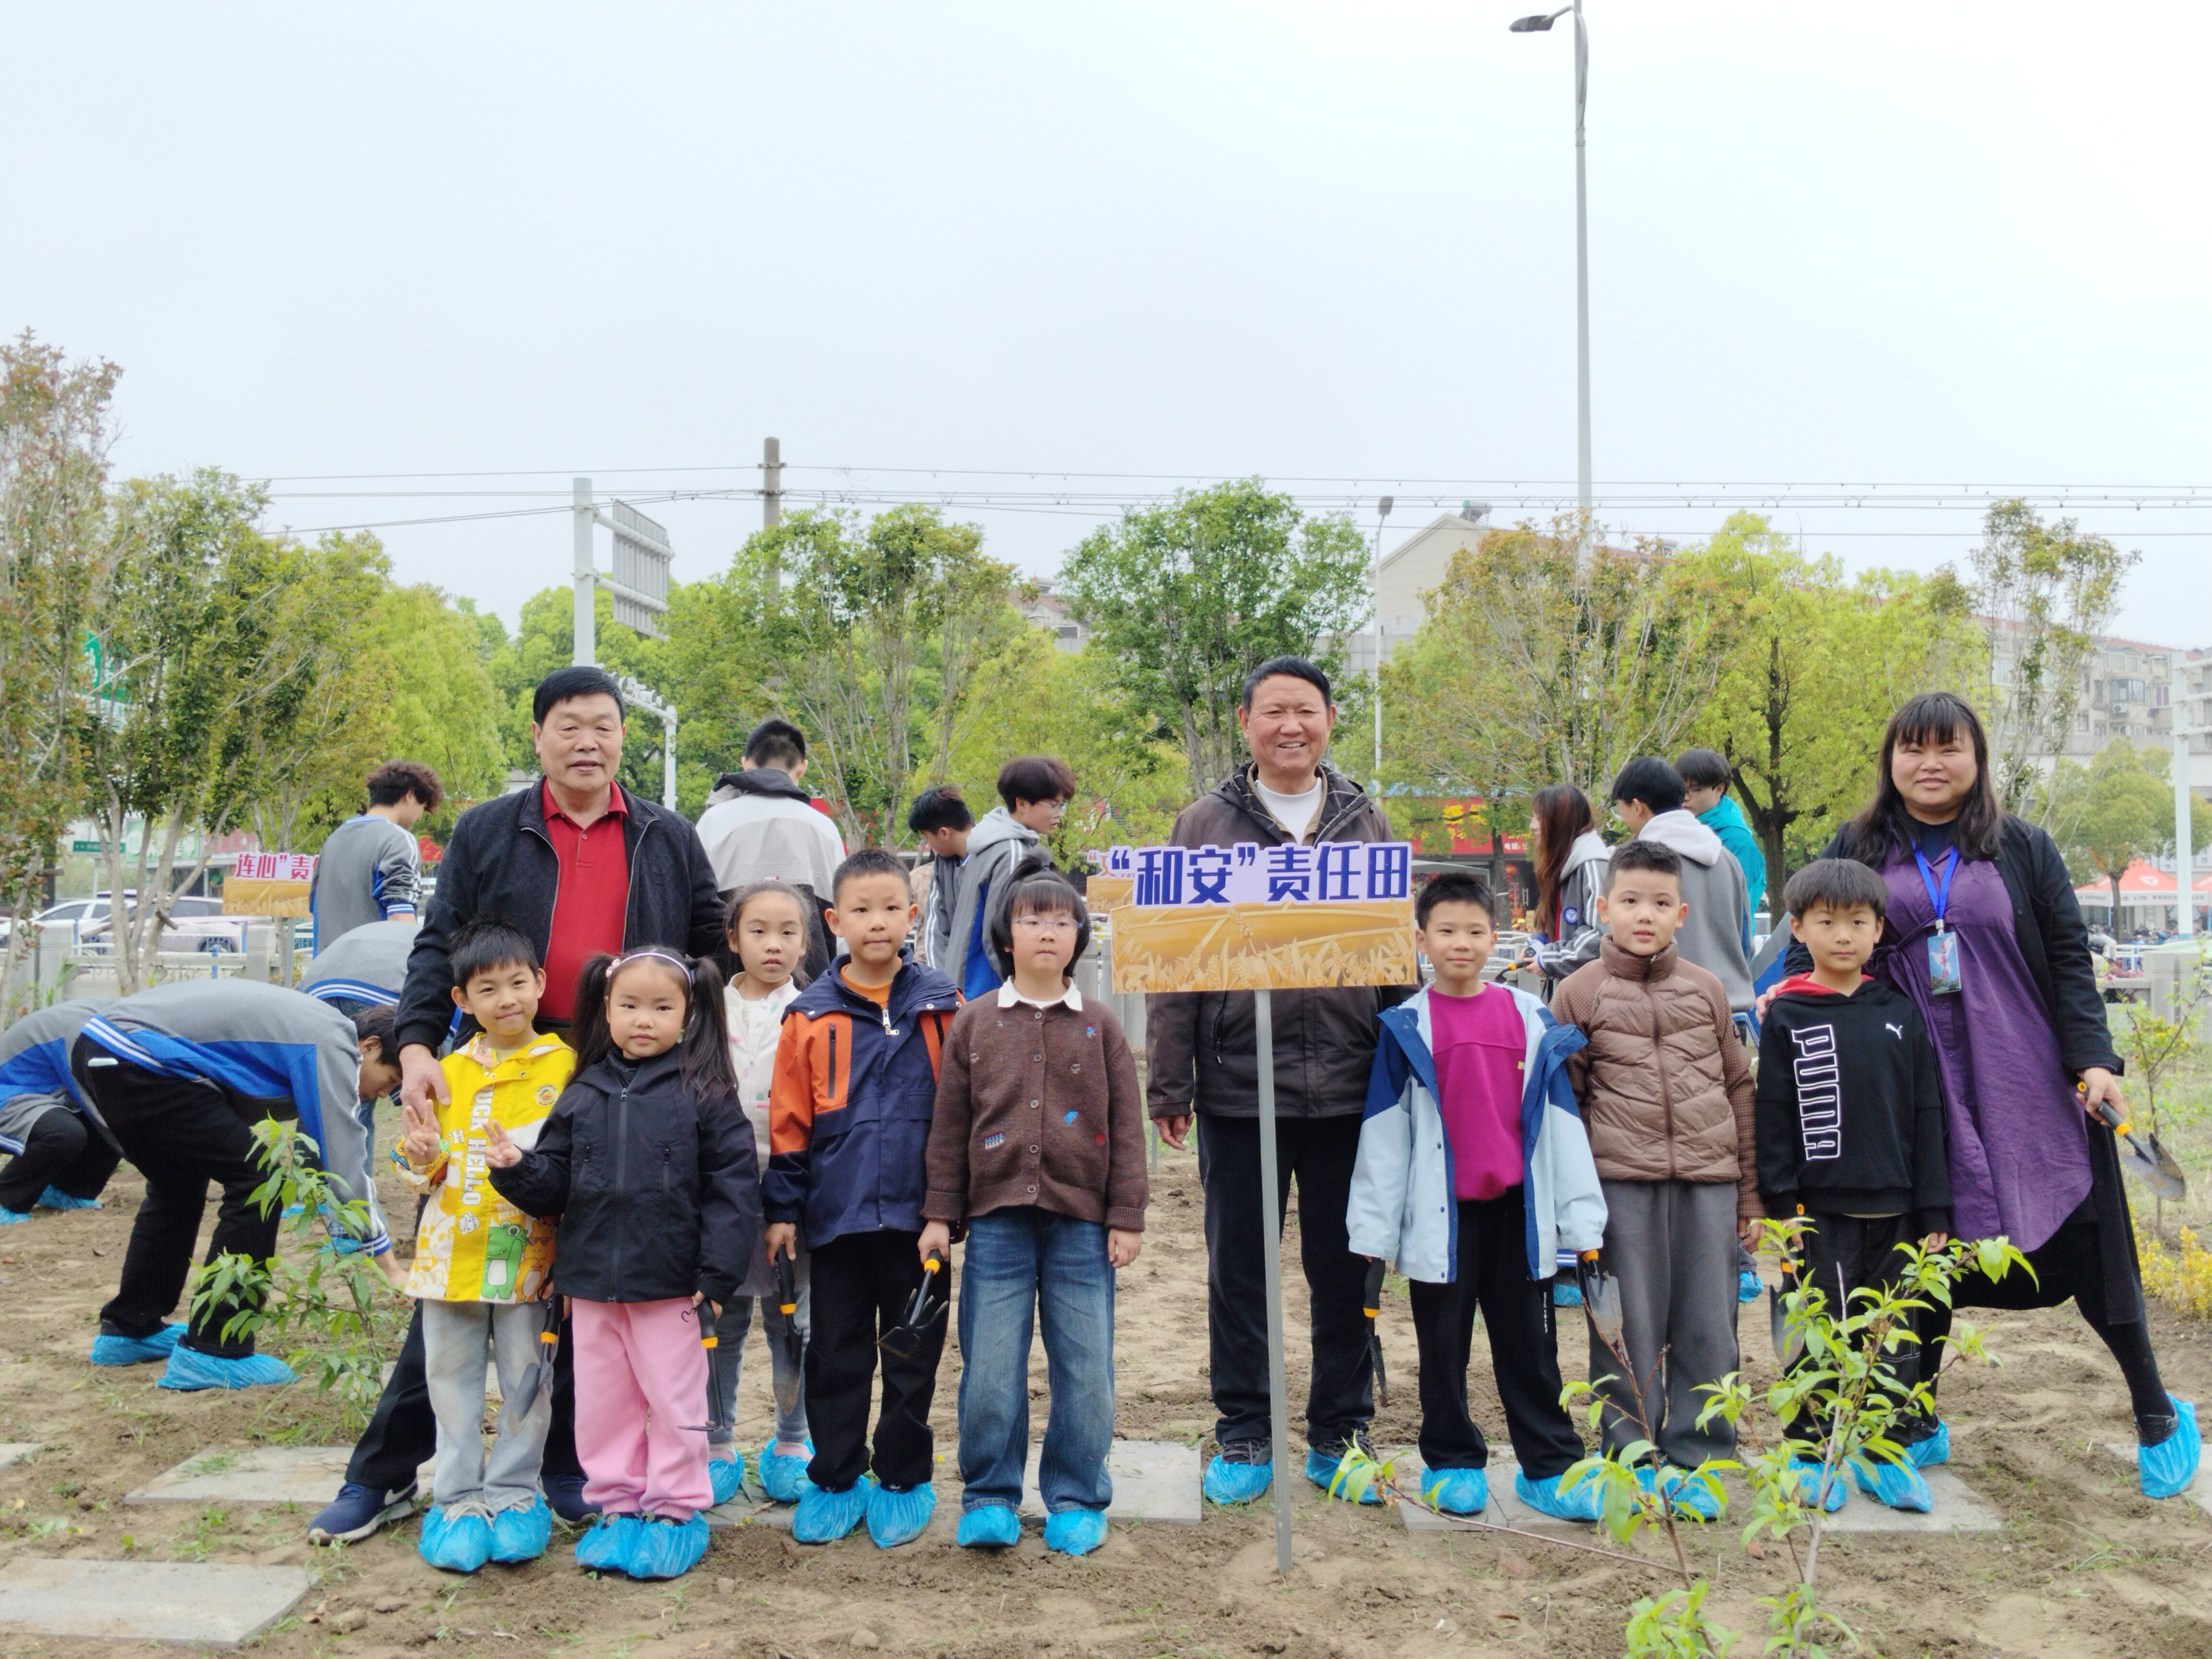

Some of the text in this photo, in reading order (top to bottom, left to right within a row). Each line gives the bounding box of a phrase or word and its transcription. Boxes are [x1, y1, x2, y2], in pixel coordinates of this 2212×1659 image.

[1111, 844, 1408, 906] “和安”责任田
[461, 1138, 487, 1206] HELLO
